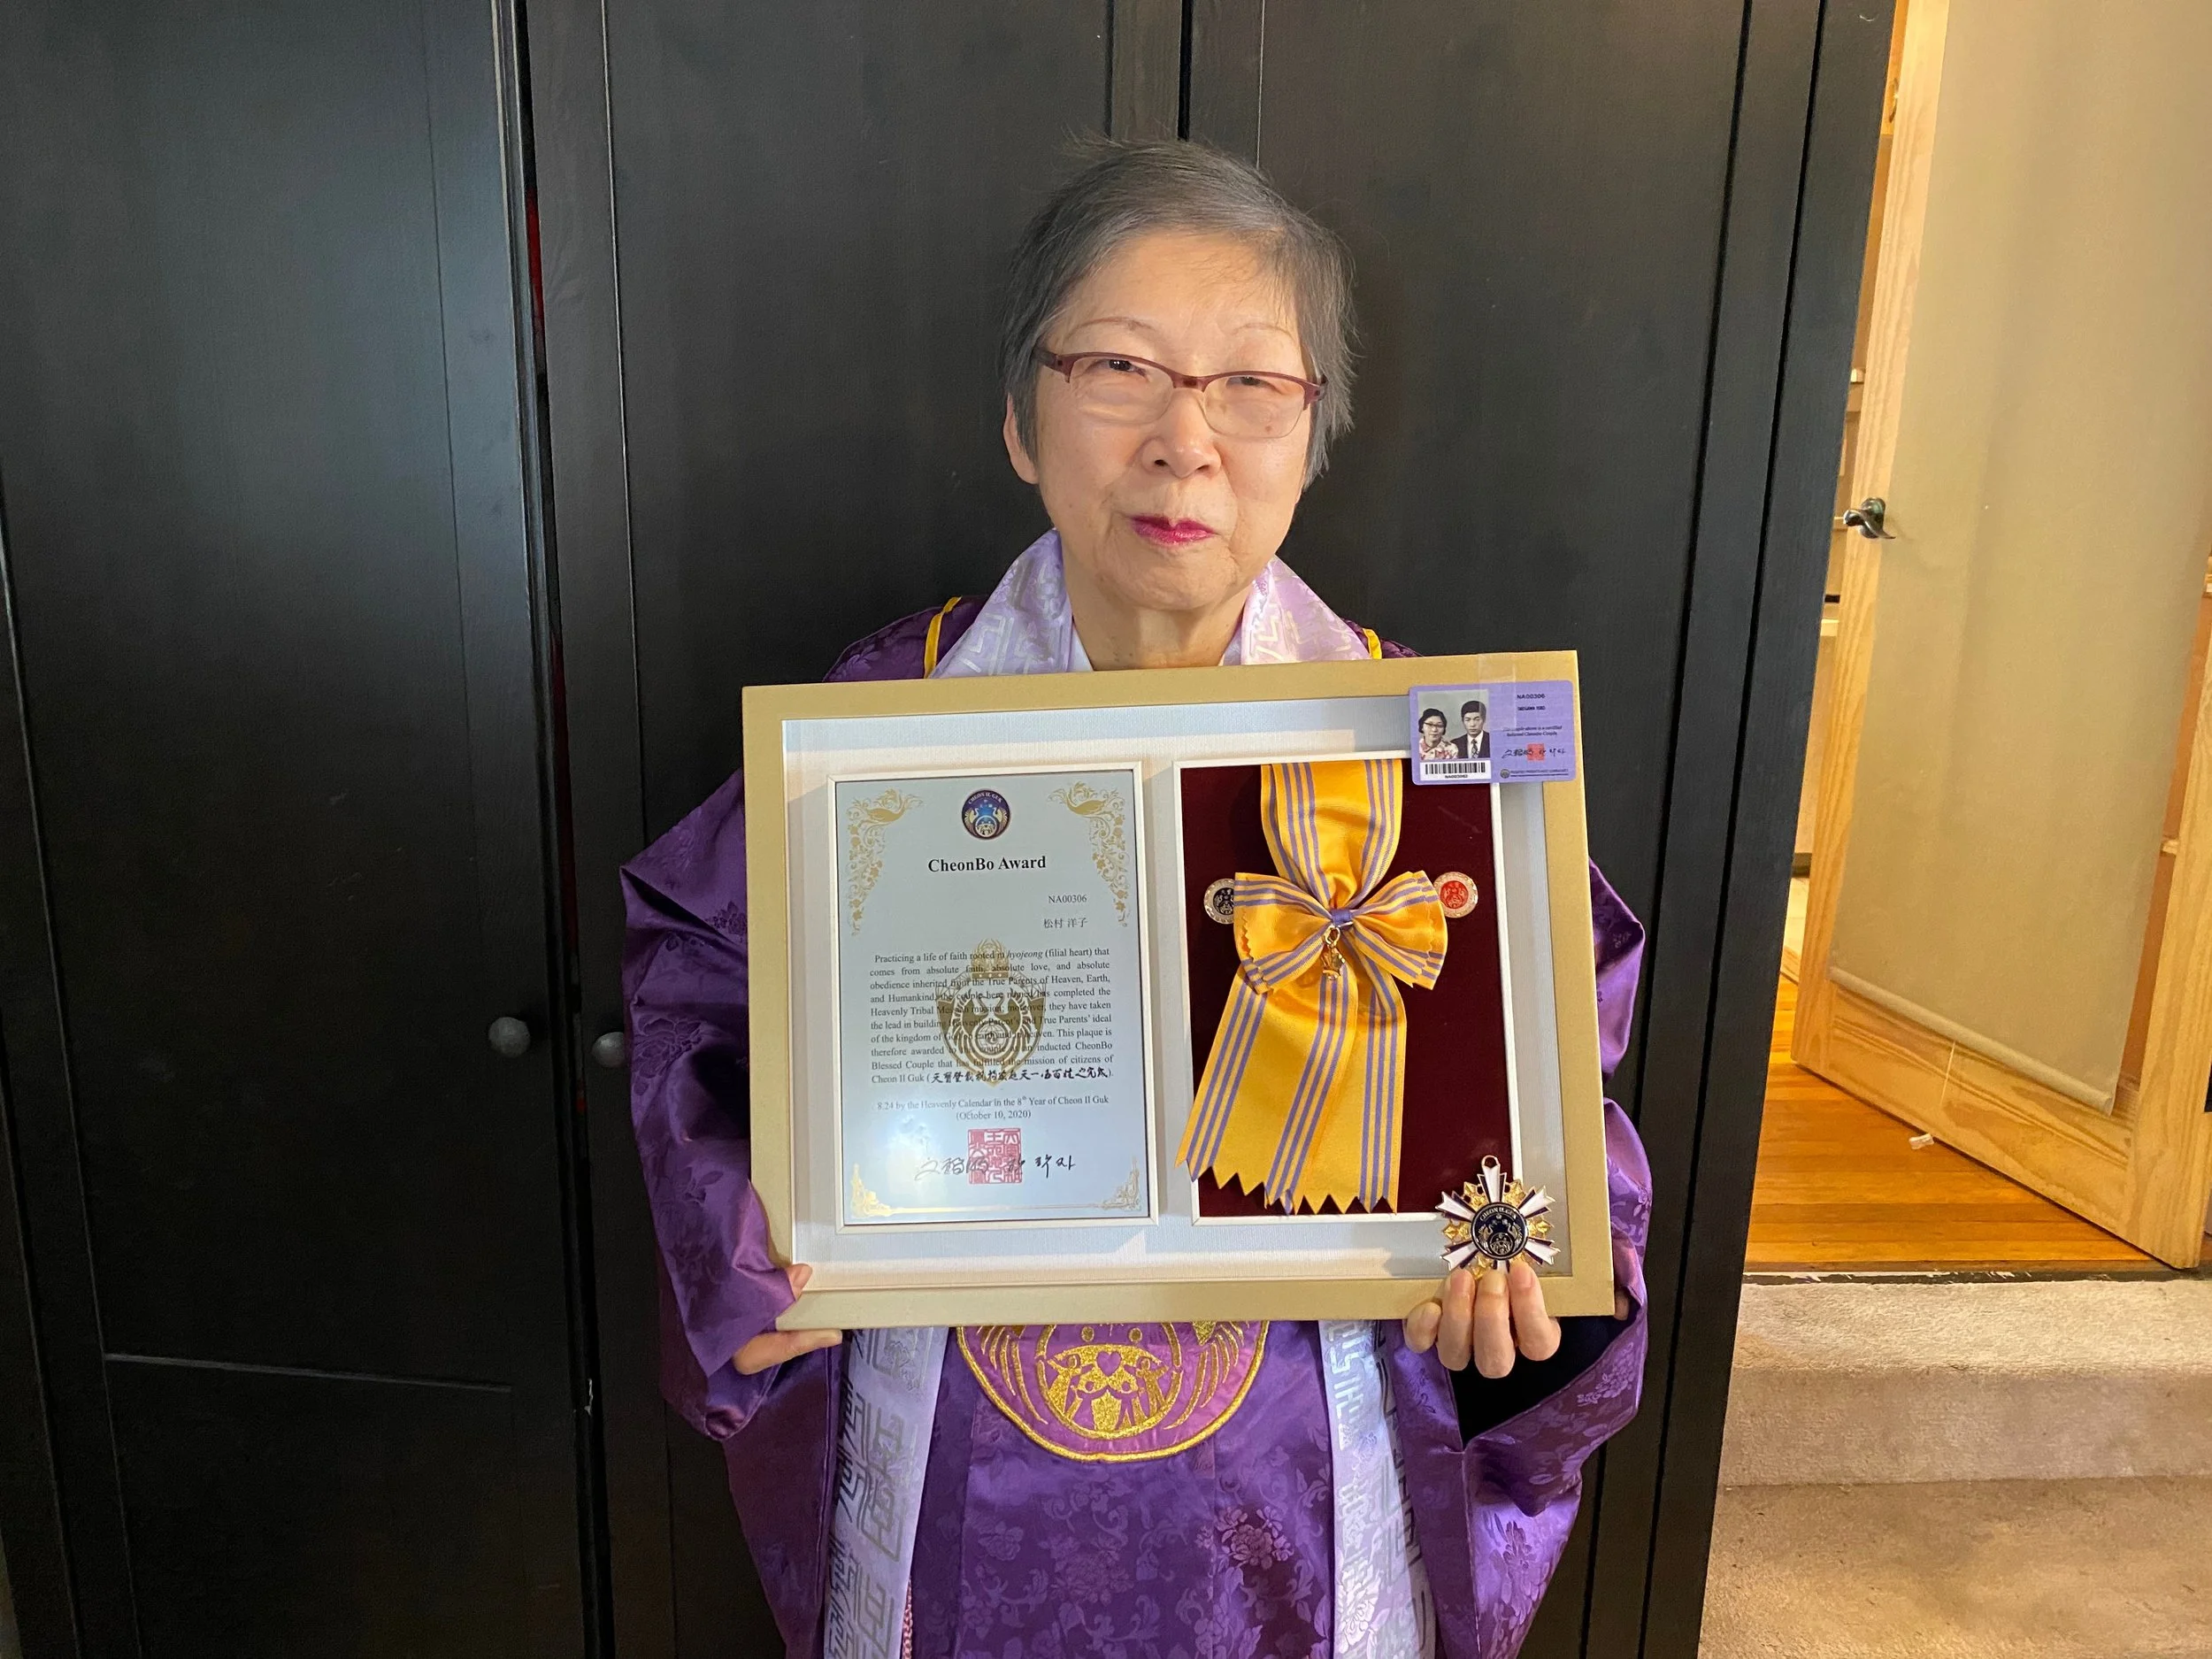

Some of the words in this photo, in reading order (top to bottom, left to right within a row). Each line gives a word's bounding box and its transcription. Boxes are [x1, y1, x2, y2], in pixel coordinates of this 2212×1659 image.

[928, 856, 995, 872] CheonBo
[998, 856, 1047, 870] Award
[1048, 895, 1087, 903] NA00306
[1043, 918, 1064, 929] 松村
[1067, 918, 1088, 928] 洋子
[874, 955, 915, 964] Practicing
[939, 952, 949, 961] of
[949, 952, 967, 961] faith
[970, 951, 995, 960] rooted
[1007, 949, 1043, 961] hyojeong
[1045, 949, 1067, 958] (filial
[1069, 948, 1093, 957] heart)
[991, 963, 1025, 972] absolute
[1031, 963, 1050, 972] love,
[870, 980, 910, 989] obedience
[912, 979, 948, 988] inherited
[1009, 976, 1037, 986] Parents
[1040, 975, 1049, 984] of
[1051, 975, 1083, 984] Heaven,
[1087, 974, 1110, 983] Earth,
[1054, 987, 1094, 998] completed
[871, 1008, 908, 1017] Heavenly
[911, 1006, 933, 1015] Tribal
[1048, 1003, 1066, 1014] they
[1069, 1002, 1087, 1010] have
[1089, 1001, 1111, 1010] taken
[871, 1021, 883, 1030] the
[885, 1020, 902, 1029] lead
[913, 1018, 945, 1030] buildin
[1093, 1014, 1111, 1023] ideal
[871, 1034, 880, 1043] of
[881, 1034, 895, 1043] the
[896, 1033, 931, 1044] kingdom
[933, 1033, 942, 1041] of
[1056, 1029, 1074, 1038] This
[1077, 1028, 1103, 1040] plaque
[1105, 1027, 1112, 1036] is
[910, 1047, 944, 1056] awarded
[1037, 1042, 1071, 1051] inducted
[1075, 1041, 1112, 1050] CheonBo
[872, 1061, 902, 1070] Blessed
[905, 1060, 934, 1070] Couple
[938, 1059, 952, 1068] that
[1024, 1056, 1055, 1065] mission
[1071, 1055, 1101, 1064] citizens
[1105, 1054, 1114, 1063] of
[872, 1074, 896, 1084] Cheon
[908, 1073, 925, 1083] Guk
[877, 1101, 894, 1110] 8.24
[895, 1102, 905, 1110] by
[907, 1101, 919, 1110] the
[921, 1100, 956, 1110] Heavenly
[958, 1098, 992, 1108] Calendar
[1028, 1097, 1047, 1106] Year
[1048, 1096, 1057, 1105] of
[1057, 1095, 1083, 1105] Cheon
[1092, 1094, 1110, 1104] Guk
[956, 1110, 991, 1121] (October
[994, 1110, 1005, 1120] 10,
[1008, 1110, 1032, 1119] 2020)
